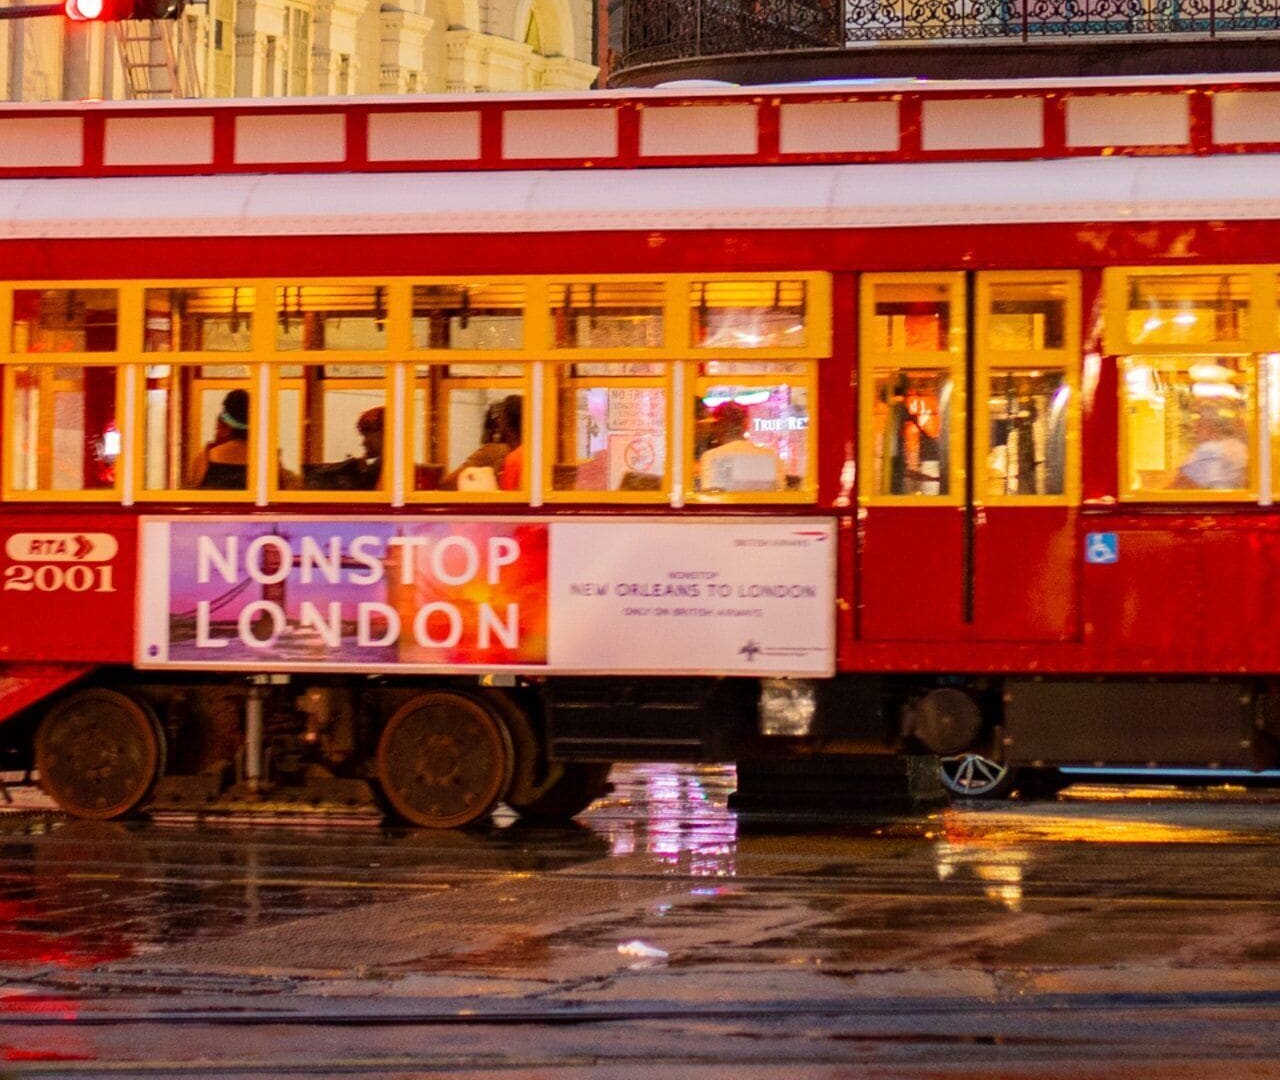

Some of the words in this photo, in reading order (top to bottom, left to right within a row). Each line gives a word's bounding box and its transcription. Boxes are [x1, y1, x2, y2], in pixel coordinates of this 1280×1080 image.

[752, 418, 783, 431] TRUE
[28, 539, 68, 556] RTA
[197, 535, 521, 587] NONSTOP
[3, 564, 118, 593] 2001
[570, 583, 609, 597] NEW
[615, 583, 701, 598] ORLEANS
[708, 583, 732, 598] TO
[736, 583, 817, 598] LONDON
[195, 601, 520, 650] LONDON
